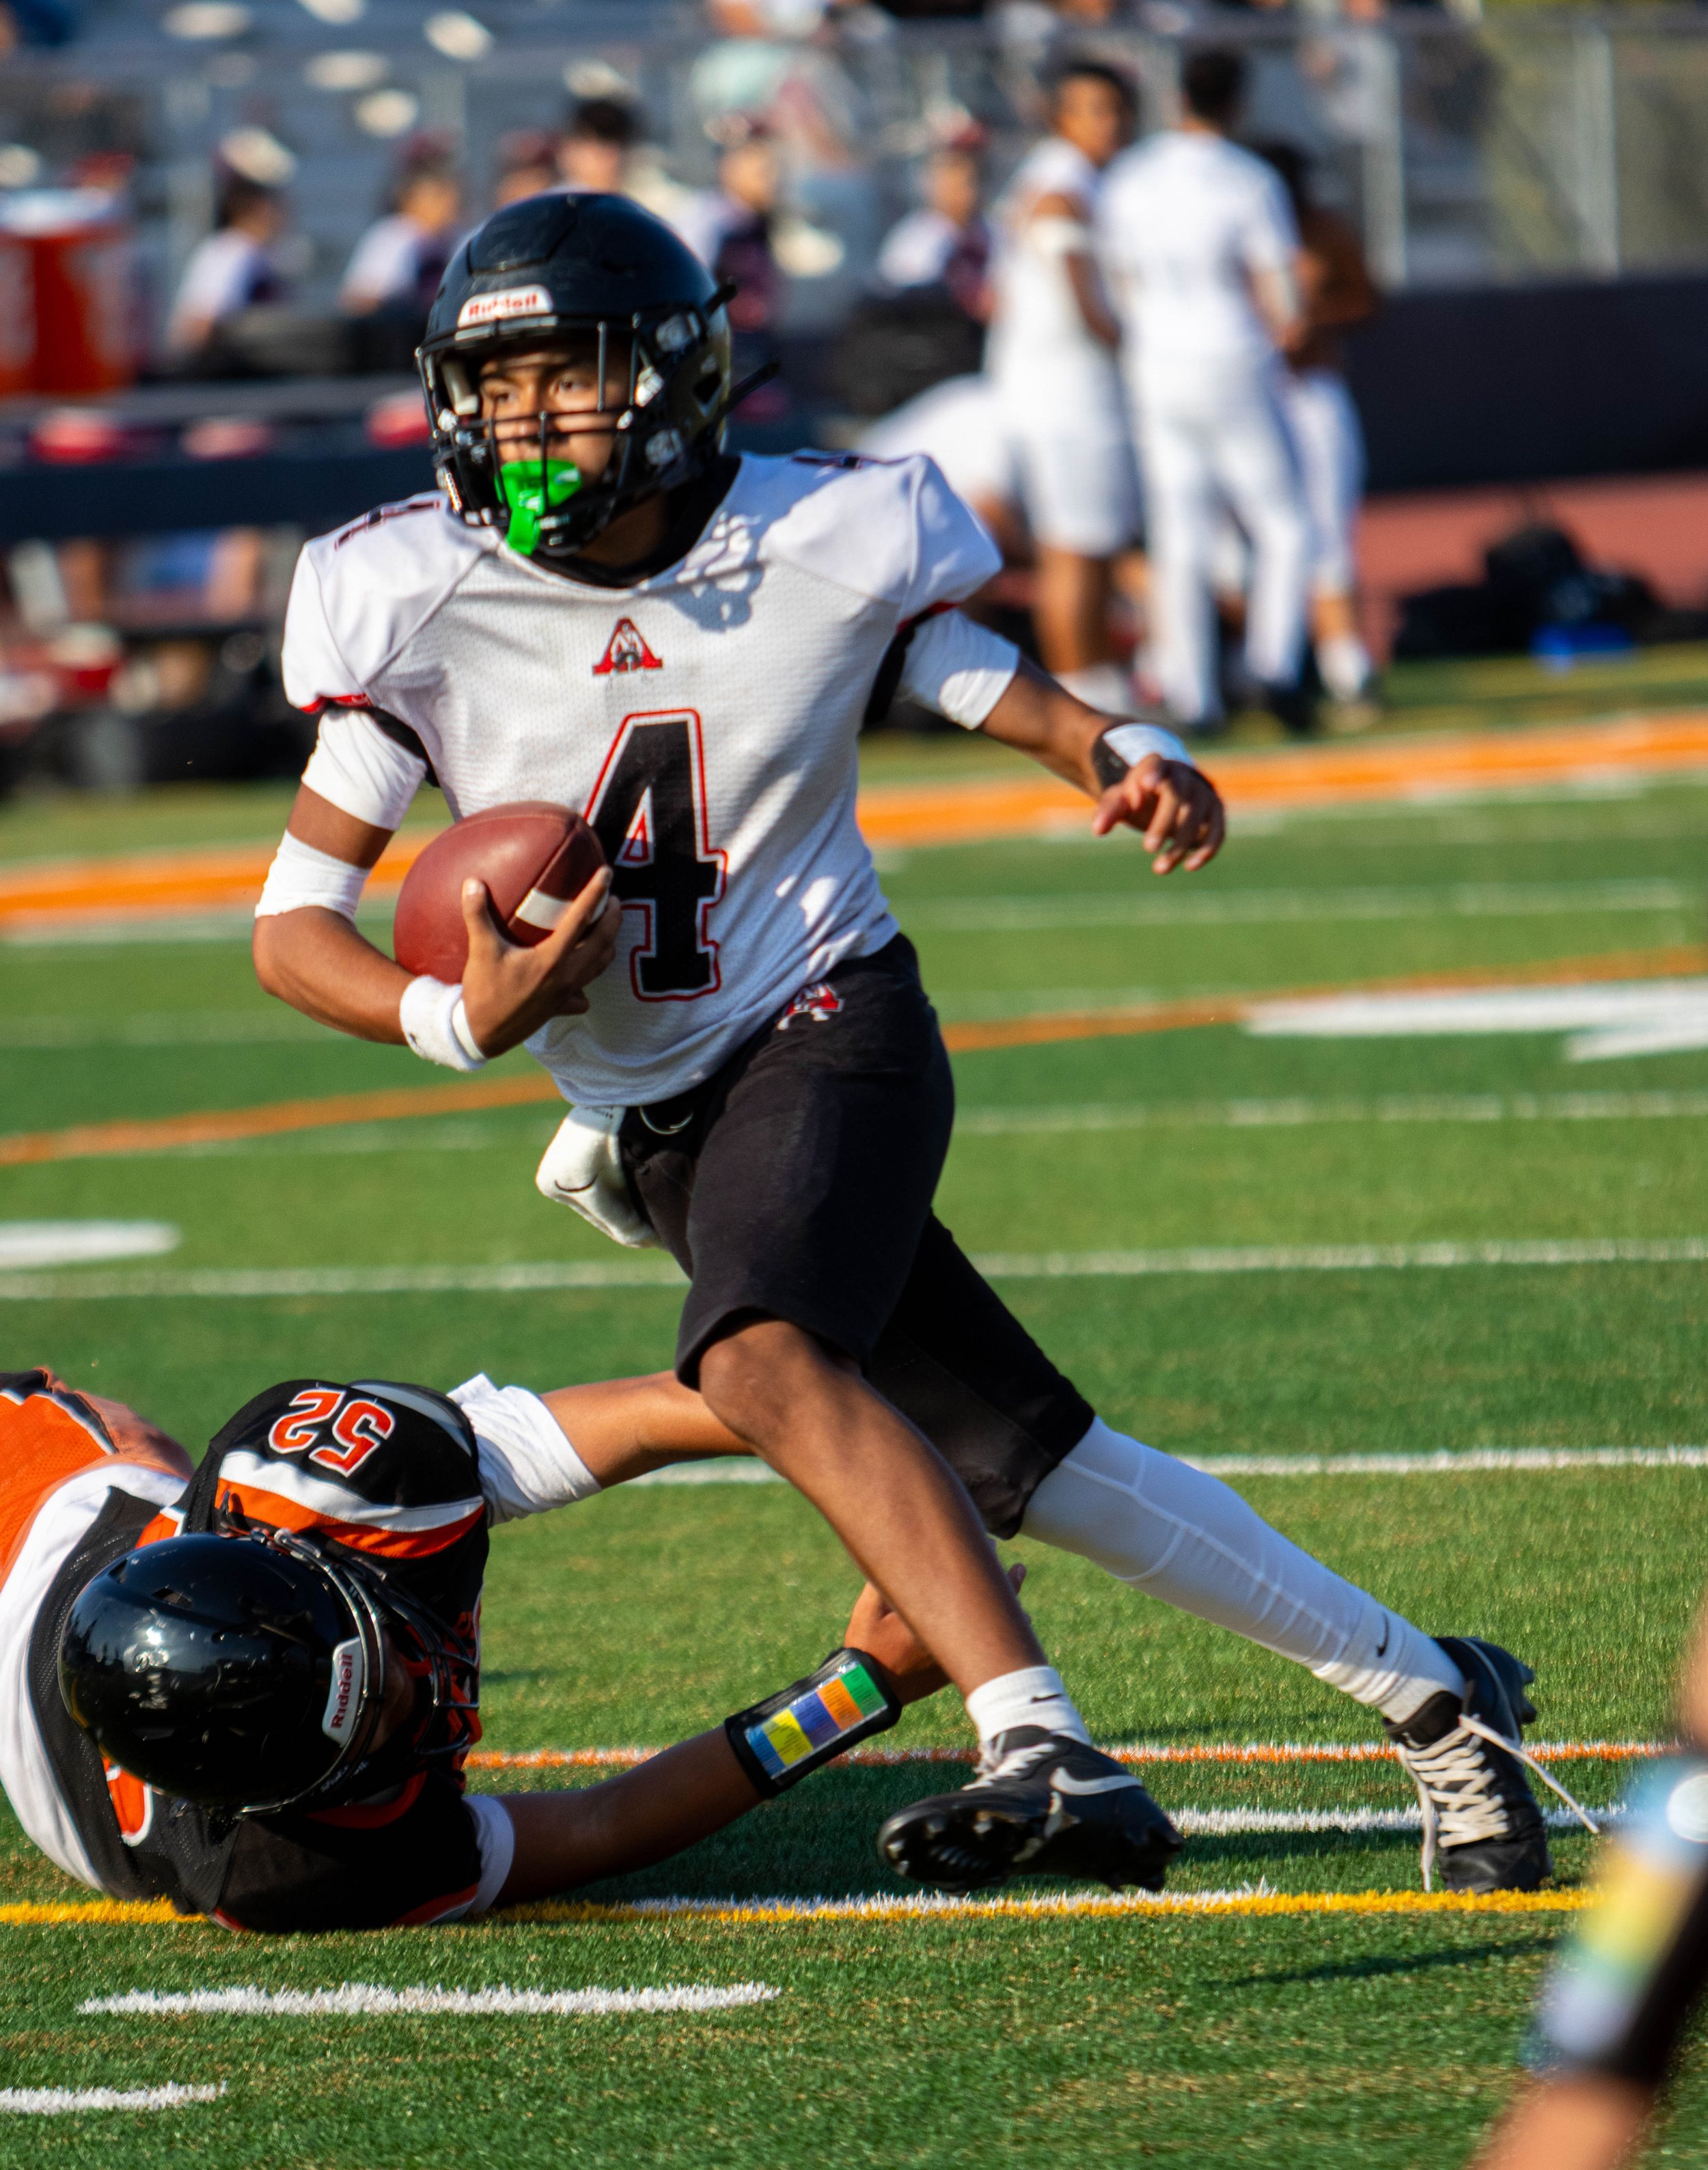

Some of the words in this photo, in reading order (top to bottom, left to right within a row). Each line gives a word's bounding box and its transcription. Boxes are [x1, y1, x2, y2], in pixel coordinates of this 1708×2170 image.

[584, 708, 728, 1002] 4
[268, 1388, 396, 1479] 52
[330, 1653, 353, 1729] Riddell
